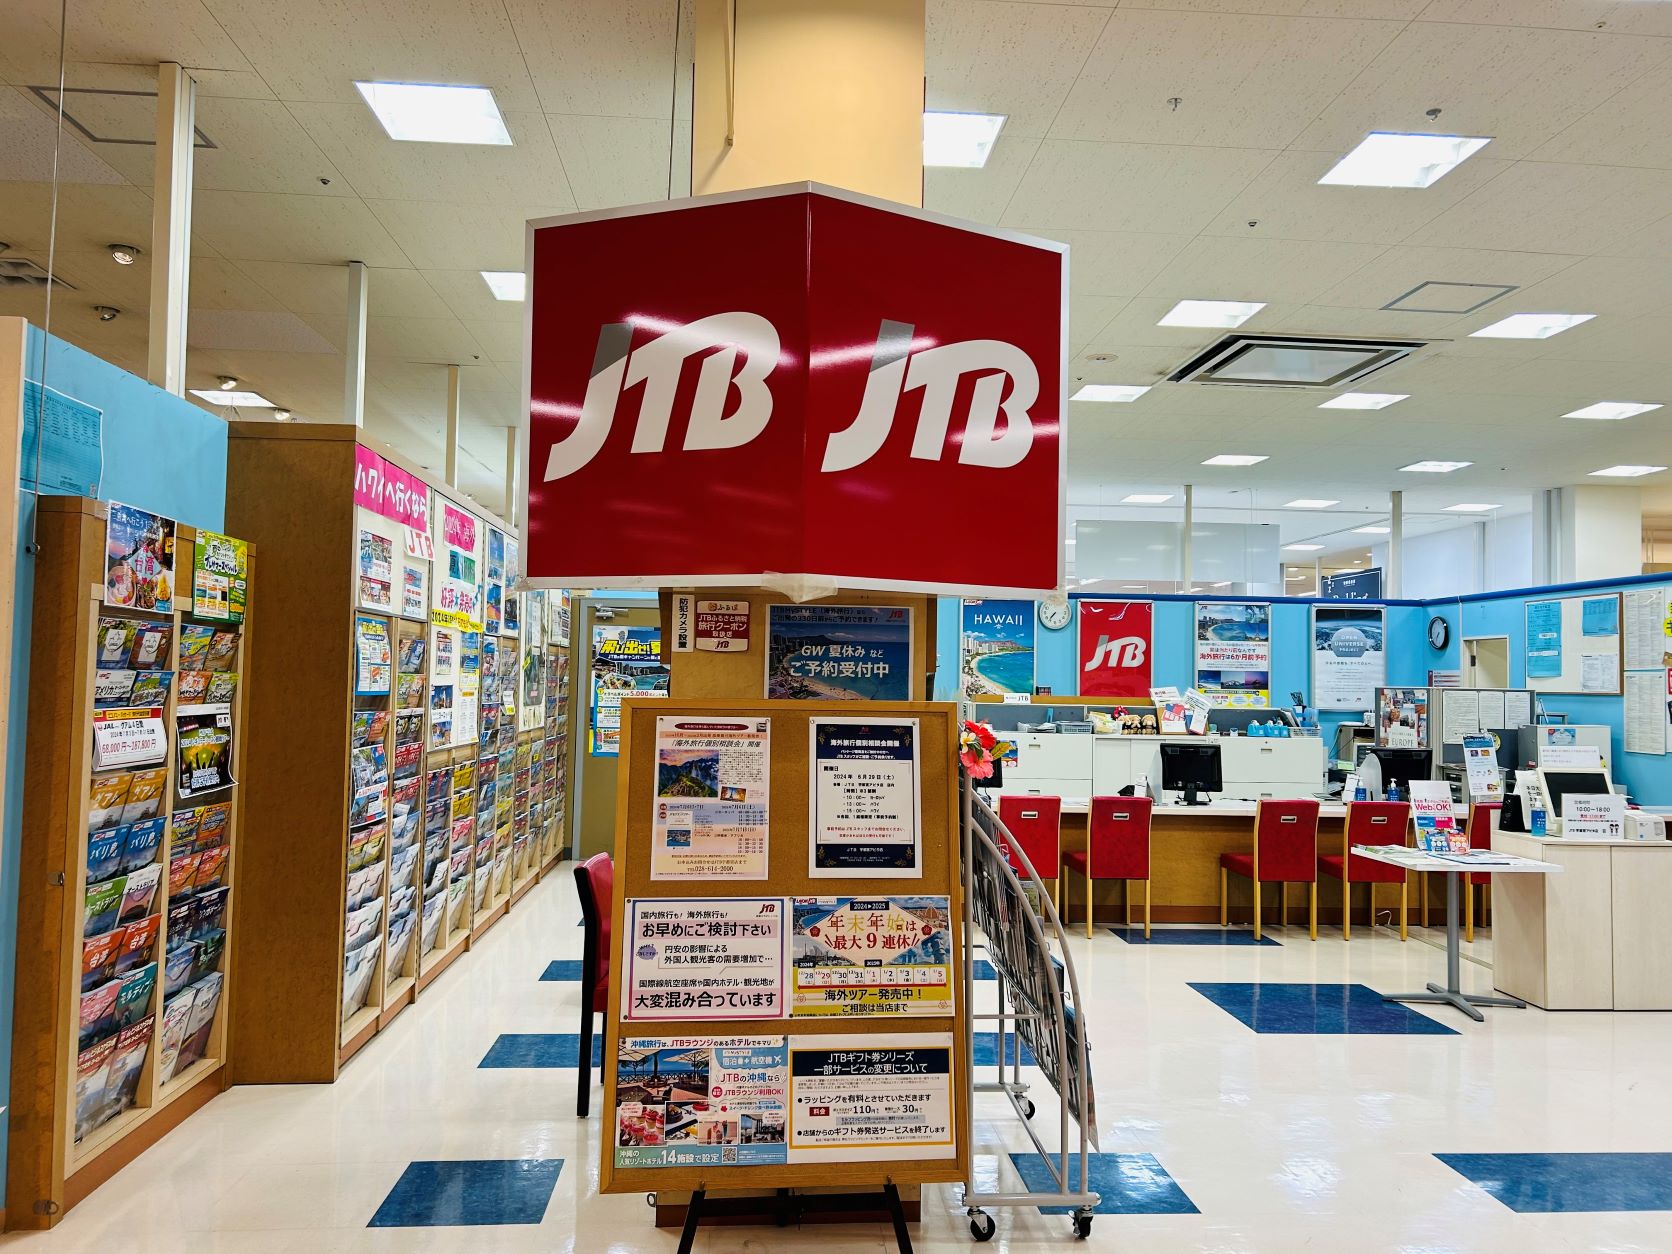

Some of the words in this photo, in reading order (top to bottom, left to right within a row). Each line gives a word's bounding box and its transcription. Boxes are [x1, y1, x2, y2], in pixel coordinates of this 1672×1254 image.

[544, 311, 781, 483] JTB
[820, 319, 1039, 473] JTB
[355, 463, 426, 521] ハワイへ行くなら
[409, 530, 433, 558] JTB
[974, 614, 1022, 625] HAWAII
[698, 622, 746, 630] 旅行クーポン
[715, 641, 729, 649] JTB
[802, 646, 826, 656] GW
[829, 645, 865, 657] 夏休み
[870, 650, 884, 658] など
[1085, 635, 1147, 672] JTB
[790, 661, 889, 678] ご予約受付中
[131, 833, 156, 848] バリ島
[641, 911, 683, 919] 国内旅行も!
[687, 911, 728, 919] 海外旅行も!
[760, 904, 775, 914] JTB
[827, 913, 916, 933] 年末年始は
[642, 922, 771, 938] お早めにご検討下さい
[833, 933, 911, 950] 最大9連休
[664, 944, 728, 953] 円安の影響による
[639, 978, 774, 988] 国際線航空座席や国内ホテル・観光地が
[635, 992, 776, 1009] 大変混み合っています
[824, 989, 921, 1001] 海外ツアー発売中!
[842, 1004, 908, 1013] ご相談は当店まで
[723, 1057, 738, 1065] 宿泊
[828, 1051, 914, 1063] JTBギフト券シリーズ
[814, 1063, 928, 1075] 一部サービスの変更について
[720, 1072, 780, 1083] JTBの沖縄なら
[723, 1088, 784, 1096] JTBラウンジ利用OK!
[804, 1094, 931, 1104] ラッピングを有料とさせていただきます
[803, 1126, 945, 1137] 店舗からのギフト券発送サービスを終了します
[619, 1150, 639, 1158] 沖縄の
